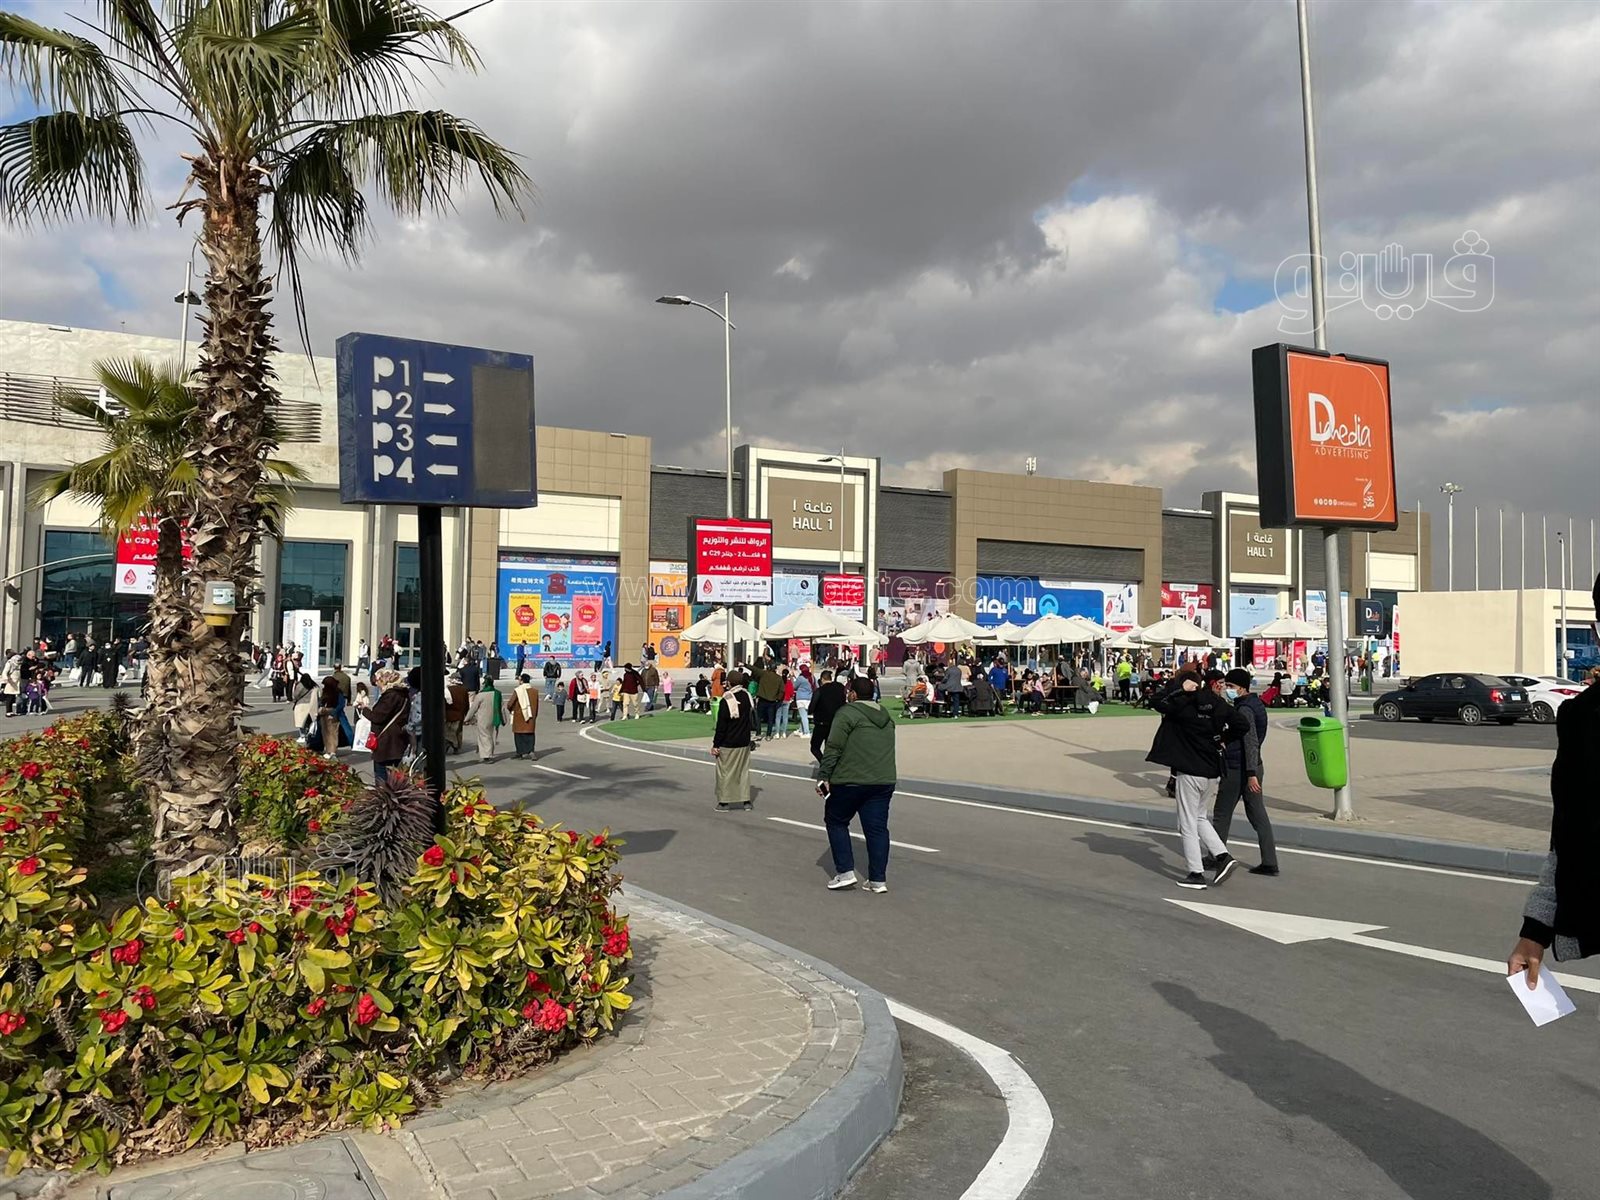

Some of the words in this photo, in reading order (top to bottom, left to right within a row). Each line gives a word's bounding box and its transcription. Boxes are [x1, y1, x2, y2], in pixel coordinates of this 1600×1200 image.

[373, 356, 410, 386] P1
[371, 388, 413, 419] P2
[372, 421, 414, 452] P3
[1315, 446, 1369, 460] ADVERTISING
[373, 454, 415, 484] P4
[804, 499, 833, 514] قاعة
[793, 517, 823, 530] HALL
[827, 518, 833, 530] 1
[703, 537, 728, 545] والتوزيع
[730, 536, 746, 546] للنشر
[748, 538, 766, 547] الرواق
[1254, 532, 1273, 544] قاعة
[1246, 546, 1267, 558] HALL
[1268, 547, 1273, 558] 1
[302, 619, 312, 627] S3
